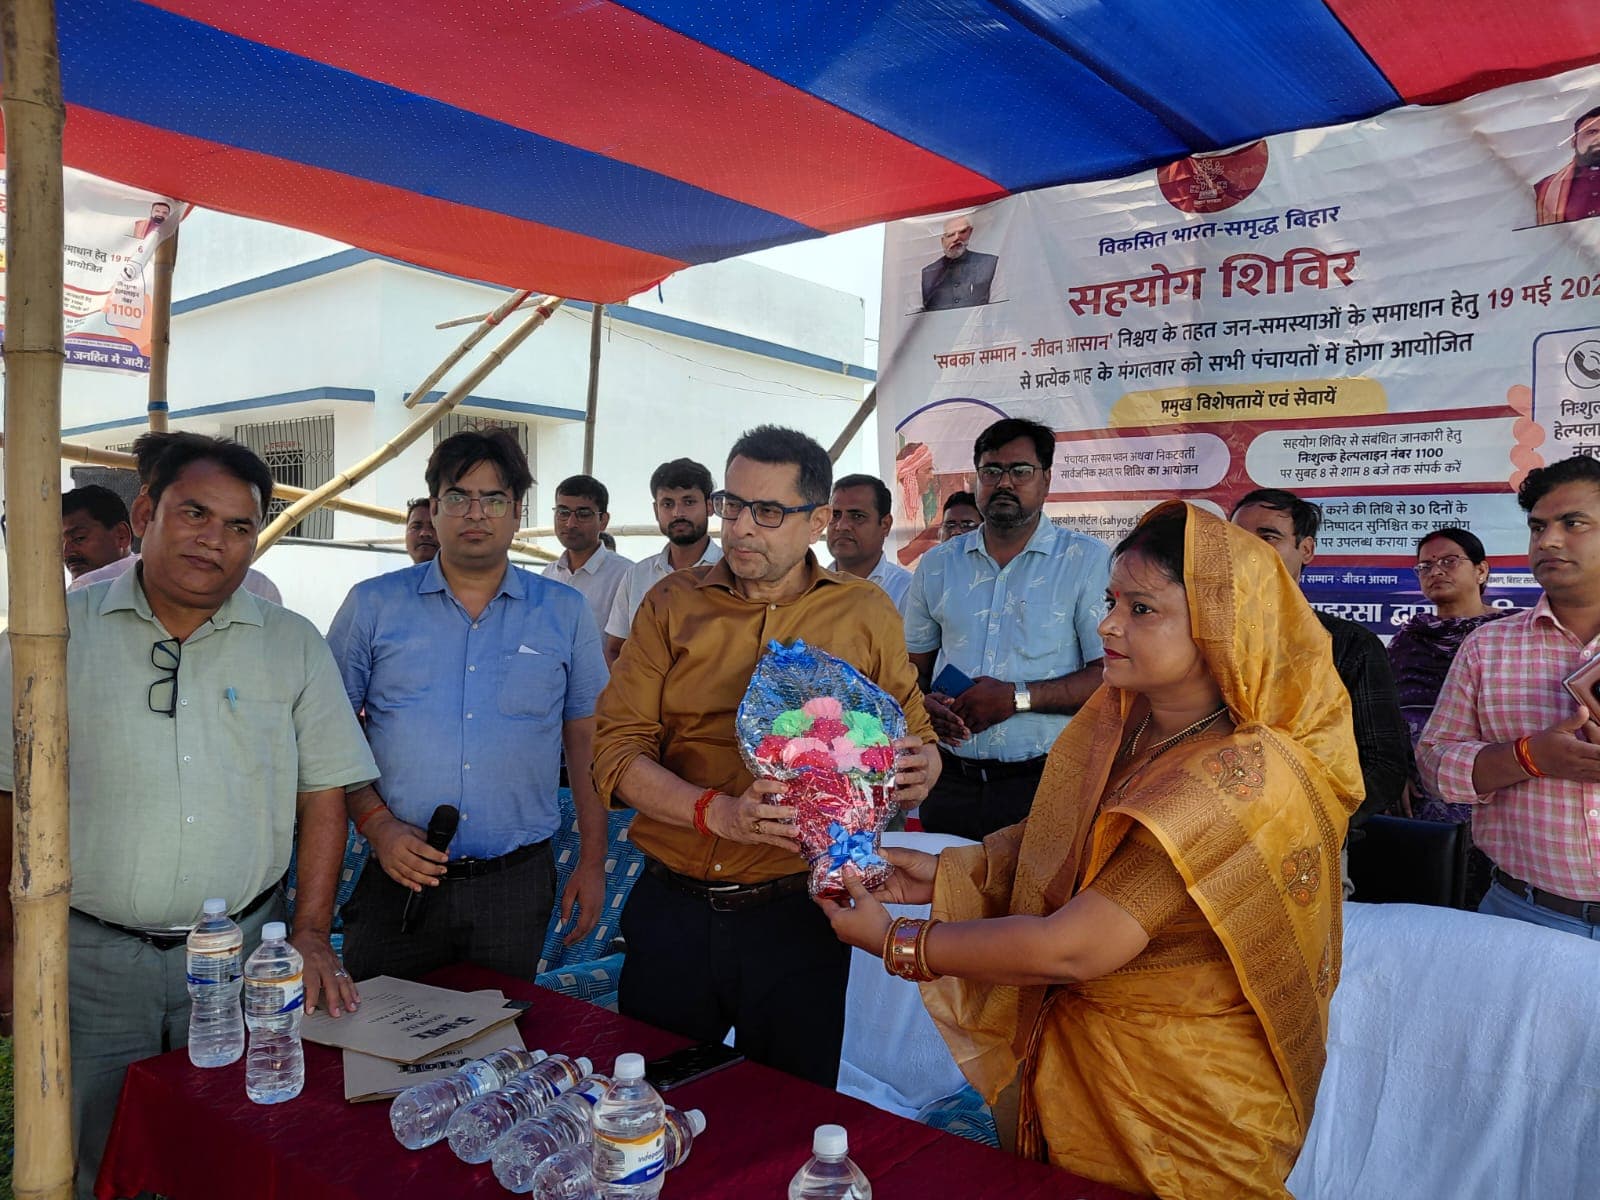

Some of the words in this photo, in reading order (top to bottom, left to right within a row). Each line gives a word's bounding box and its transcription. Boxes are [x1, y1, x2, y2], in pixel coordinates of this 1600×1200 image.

[1098, 230, 1166, 256] विकसित
[1172, 215, 1280, 240] भारत-समृद्ध
[1285, 205, 1341, 230] बिहार
[1068, 263, 1206, 317] सहयोग
[1219, 247, 1361, 298] शिविर
[112, 304, 141, 318] 1100
[979, 346, 1017, 365] सम्मान
[1030, 337, 1063, 358] जीवन
[1118, 328, 1156, 349] निश्चय
[1162, 321, 1178, 342] के
[1182, 321, 1216, 341] तहत
[1222, 306, 1342, 337] जन-समस्याओं
[1347, 303, 1365, 327] के
[1372, 296, 1445, 323] समाधान
[1451, 289, 1479, 319] हेतु
[1487, 288, 1514, 309] 19
[1521, 275, 1552, 306] मई
[73, 350, 109, 363] जनहित
[1019, 372, 1031, 390] से
[1035, 367, 1070, 390] प्रत्येक
[1073, 367, 1092, 386] माह
[1097, 362, 1113, 382] के
[1117, 357, 1176, 380] मंगलवार
[1181, 352, 1201, 373] को
[1209, 348, 1244, 373] सभी
[1251, 343, 1320, 370] पंचायतों
[1325, 340, 1338, 365] में
[1345, 339, 1383, 366] होगा
[1390, 330, 1474, 359] आयोजित
[1161, 395, 1192, 417] प्रमुख
[1197, 388, 1265, 412] विशेषतायें
[1268, 388, 1290, 408] एवं
[1294, 385, 1337, 407] सेवायें
[1282, 435, 1316, 450] सहयोग
[1319, 433, 1347, 448] शिविर
[1349, 432, 1359, 446] से
[1361, 431, 1397, 446] संबंधित
[1400, 428, 1443, 444] जानकारी
[1446, 427, 1463, 444] हेतु
[1064, 453, 1089, 464] पंचायत
[1091, 453, 1112, 463] सरकार
[1113, 452, 1128, 461] भवन
[1130, 451, 1154, 461] अथवा
[1156, 447, 1196, 461] निकटवर्ती
[1298, 449, 1337, 466] निःशुल्क
[1339, 448, 1388, 464] हेल्पलाइन
[1390, 446, 1412, 459] नंबर
[1415, 447, 1444, 459] 1100
[1060, 467, 1097, 479] सार्वजनिक
[1098, 468, 1113, 478] स्थल
[1114, 467, 1123, 476] पर
[1123, 465, 1145, 476] शिविर
[1147, 465, 1159, 475] का
[1161, 462, 1199, 475] आयोजन
[1280, 468, 1292, 479] पर
[1294, 468, 1318, 482] सुबह
[1320, 467, 1328, 478] 8
[1329, 464, 1338, 478] से
[1340, 465, 1360, 477] शाम
[1363, 465, 1370, 477] 8
[1372, 462, 1389, 476] बजे
[1392, 464, 1411, 475] तक
[1414, 461, 1442, 475] संपर्क
[1444, 460, 1462, 474] करें
[1326, 501, 1350, 515] करने
[1352, 501, 1366, 515] की
[1369, 501, 1393, 515] तिथि
[1396, 501, 1406, 515] से
[1409, 503, 1425, 515] 30
[1428, 500, 1453, 515] दिनों
[1455, 500, 1468, 514] के
[1078, 513, 1098, 525] पोर्टल
[1324, 519, 1363, 532] निष्पादन
[1366, 518, 1408, 536] सुनिश्चित
[1411, 520, 1428, 531] कर
[1431, 517, 1471, 530] सहयोग
[1321, 537, 1334, 547] पर
[1336, 537, 1373, 548] उपलब्ध
[1376, 535, 1408, 547] कराया
[1306, 573, 1334, 585] सम्मान
[1341, 571, 1366, 585] जीवन
[1368, 574, 1398, 585] आसान
